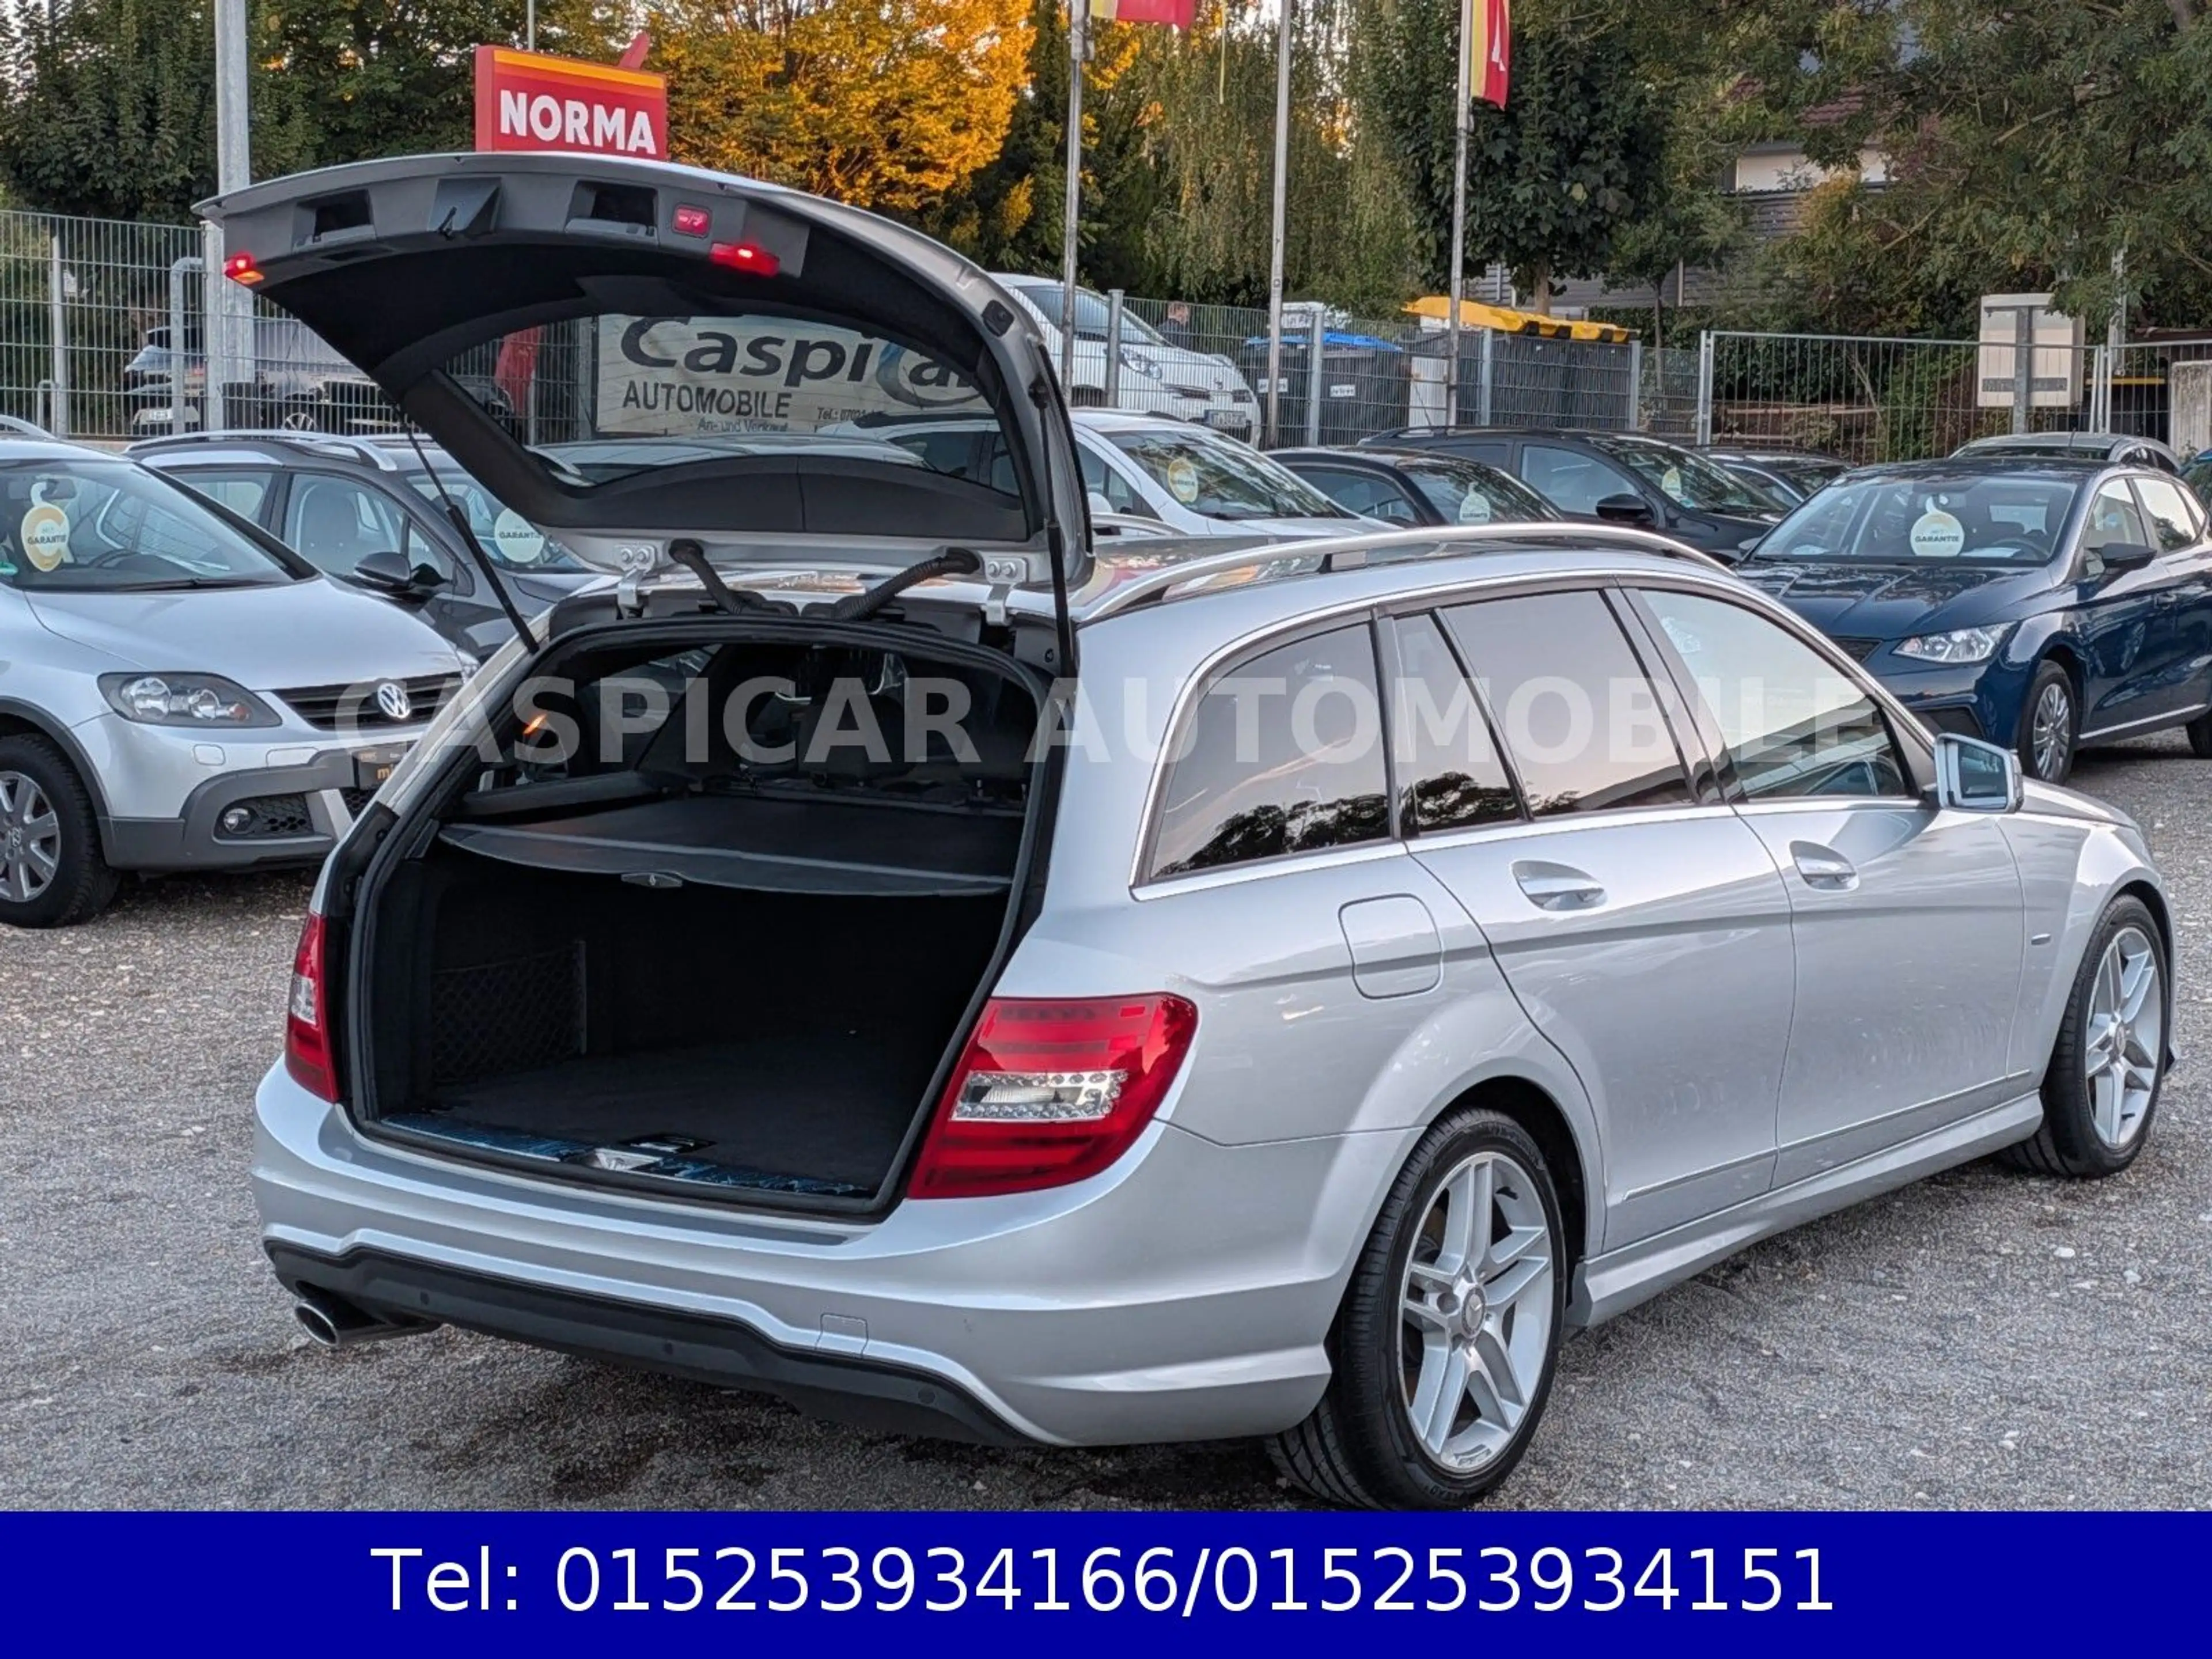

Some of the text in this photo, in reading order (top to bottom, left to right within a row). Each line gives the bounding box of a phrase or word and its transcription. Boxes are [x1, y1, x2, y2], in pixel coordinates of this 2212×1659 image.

[500, 89, 657, 154] NORMA
[623, 380, 791, 418] AUTOMOBILE
[28, 535, 67, 545] GARANTIE
